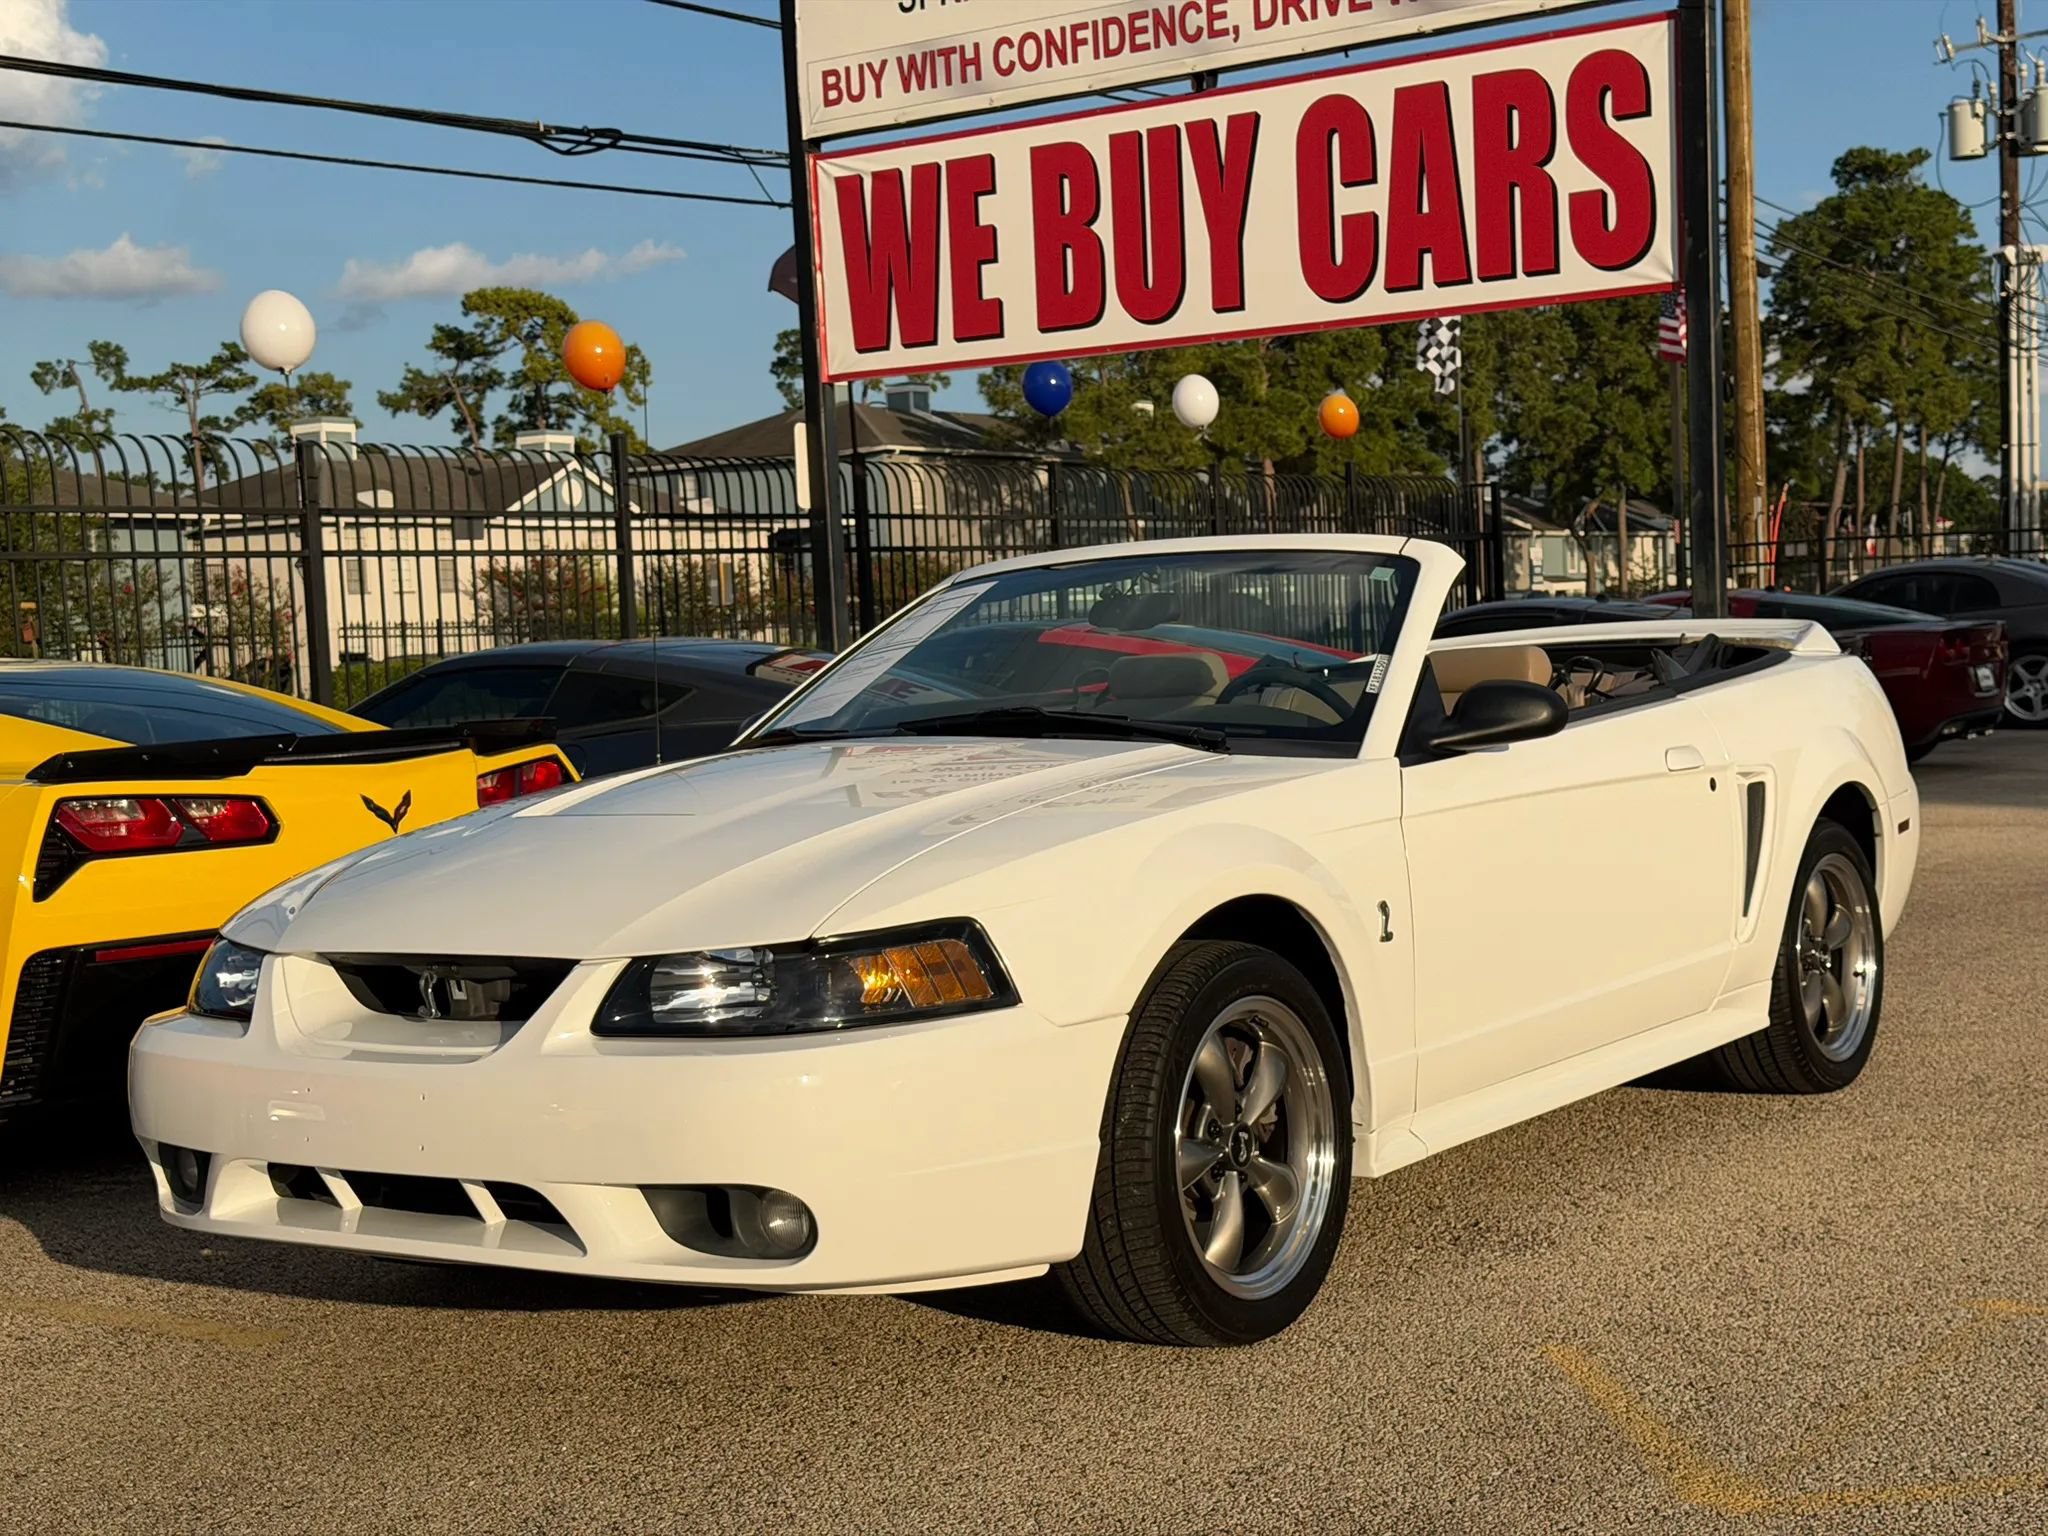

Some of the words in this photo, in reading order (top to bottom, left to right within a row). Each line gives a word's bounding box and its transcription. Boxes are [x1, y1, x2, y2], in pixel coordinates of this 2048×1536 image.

[821, 59, 888, 108] BUY
[896, 42, 982, 94] WITH
[993, 0, 1240, 77] CONFIDENCE,
[835, 153, 1004, 355] WE
[1030, 111, 1260, 334] BUY
[1295, 48, 1657, 303] CARS
